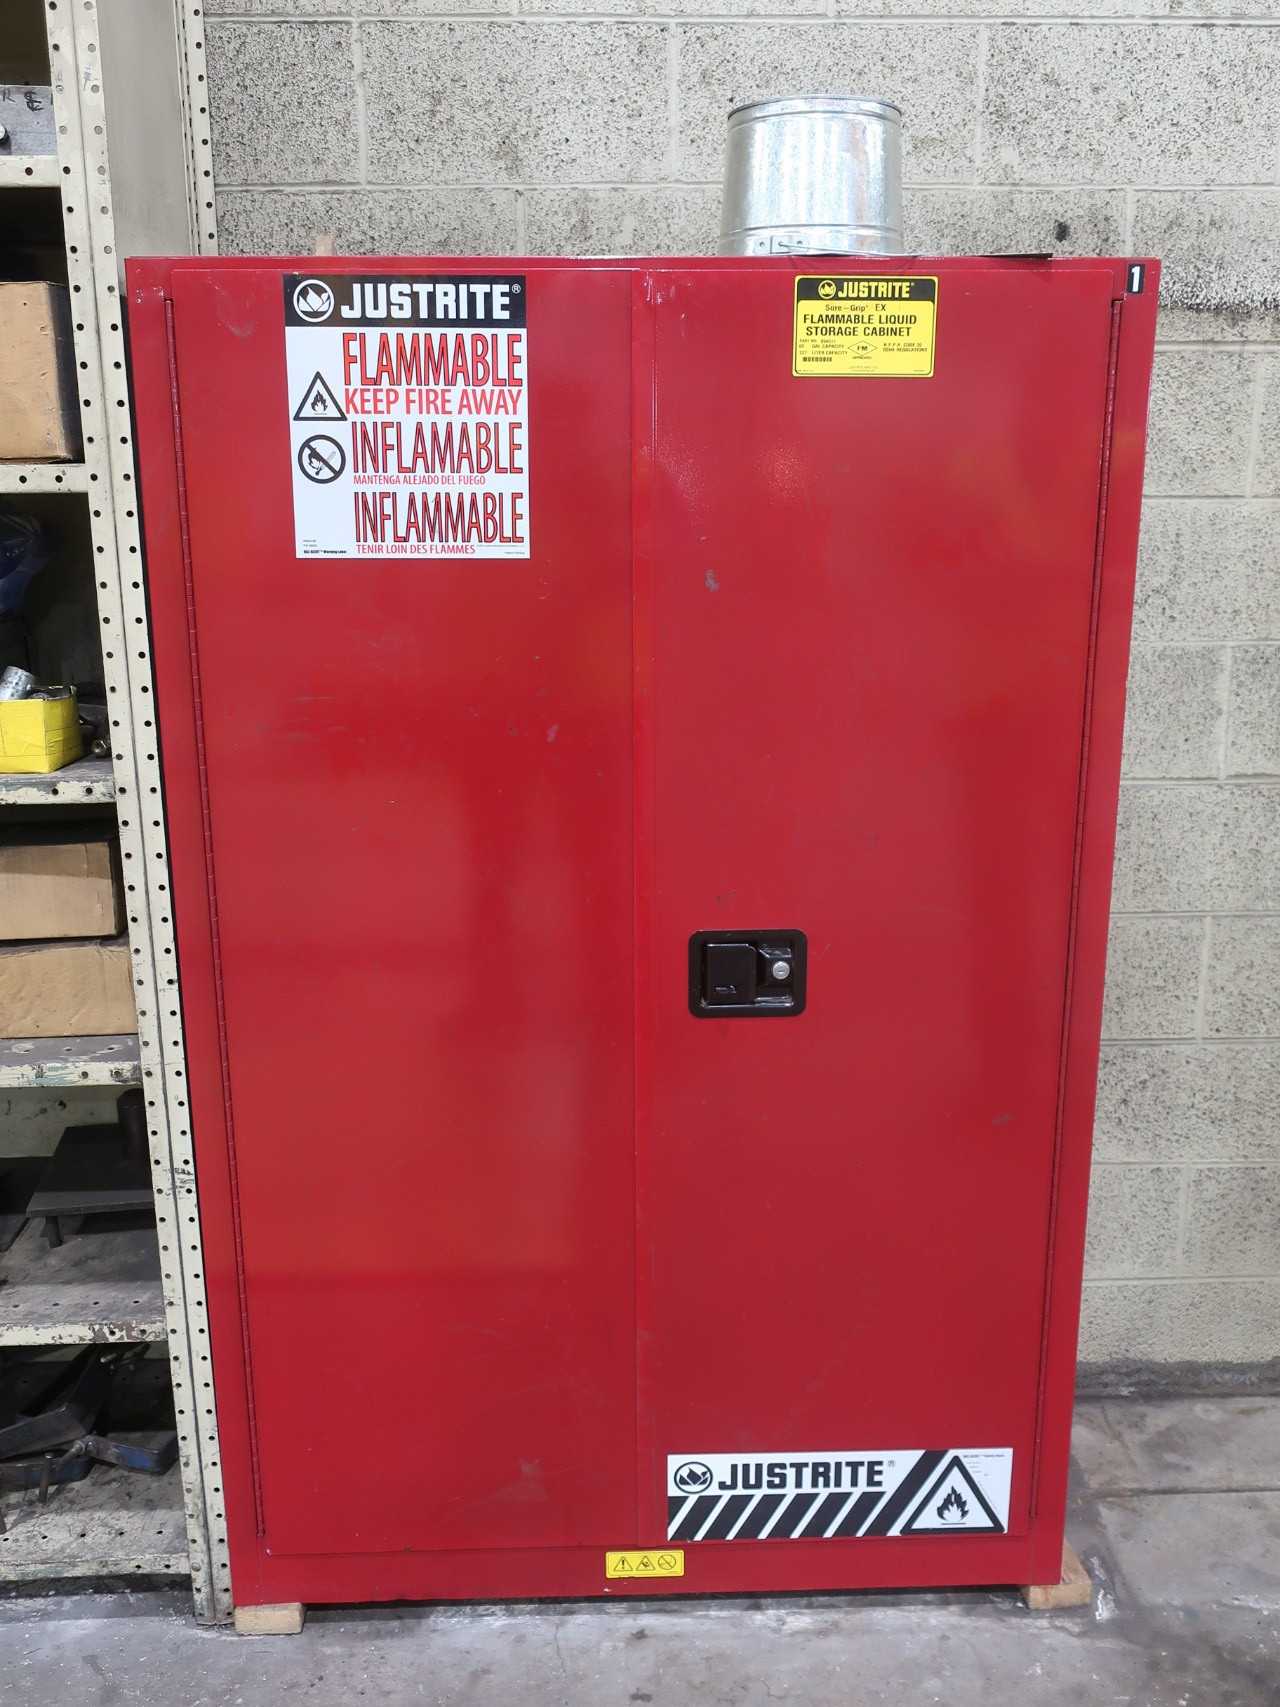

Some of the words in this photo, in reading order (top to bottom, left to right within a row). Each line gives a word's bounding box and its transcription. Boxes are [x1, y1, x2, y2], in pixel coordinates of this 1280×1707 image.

[1131, 266, 1140, 292] 1
[875, 303, 886, 312] EX
[803, 314, 874, 324] FLAMMABLE
[878, 314, 918, 325] LIQUID
[806, 326, 861, 337] STORAGE
[863, 326, 912, 337] CABINET
[342, 332, 523, 387] FLAMMABLE
[345, 388, 399, 415] KEEP
[405, 389, 452, 415] FIRE
[458, 389, 522, 415] AWAY
[351, 421, 524, 474] INFLAMABLE
[353, 474, 401, 485] MANTENGA
[402, 474, 440, 485] ALEJADO
[441, 475, 456, 485] DEL
[458, 475, 486, 485] FUEGO
[354, 492, 525, 543] INFLAMMABLE
[356, 544, 384, 554] TENIR
[386, 544, 407, 554] LOIN
[410, 544, 428, 554] DES
[429, 544, 476, 554] FLAMMES
